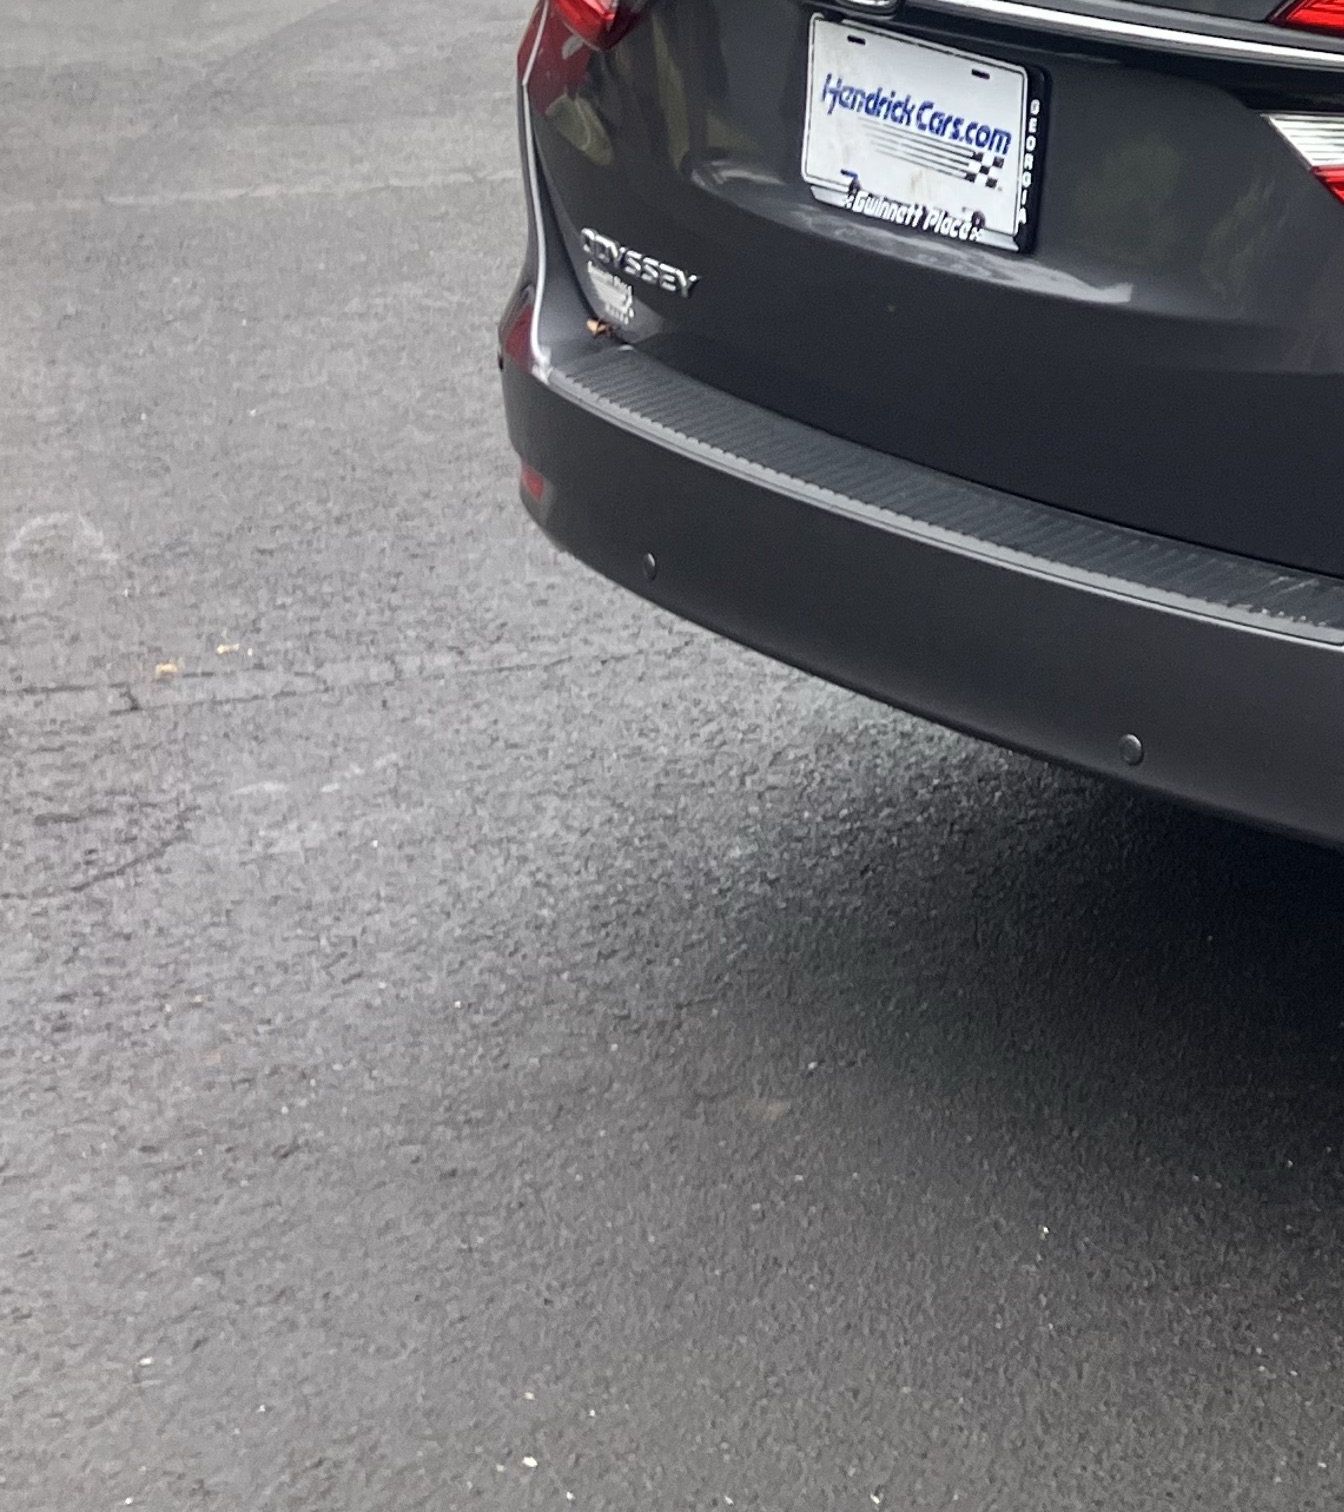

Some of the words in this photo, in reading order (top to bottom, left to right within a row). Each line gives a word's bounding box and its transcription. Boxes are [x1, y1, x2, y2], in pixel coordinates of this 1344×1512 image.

[821, 73, 1012, 155] HendrickCars.com
[1018, 99, 1040, 225] GEORGIA
[853, 190, 922, 227] Gwinnett
[581, 227, 699, 297] ODYSSEY
